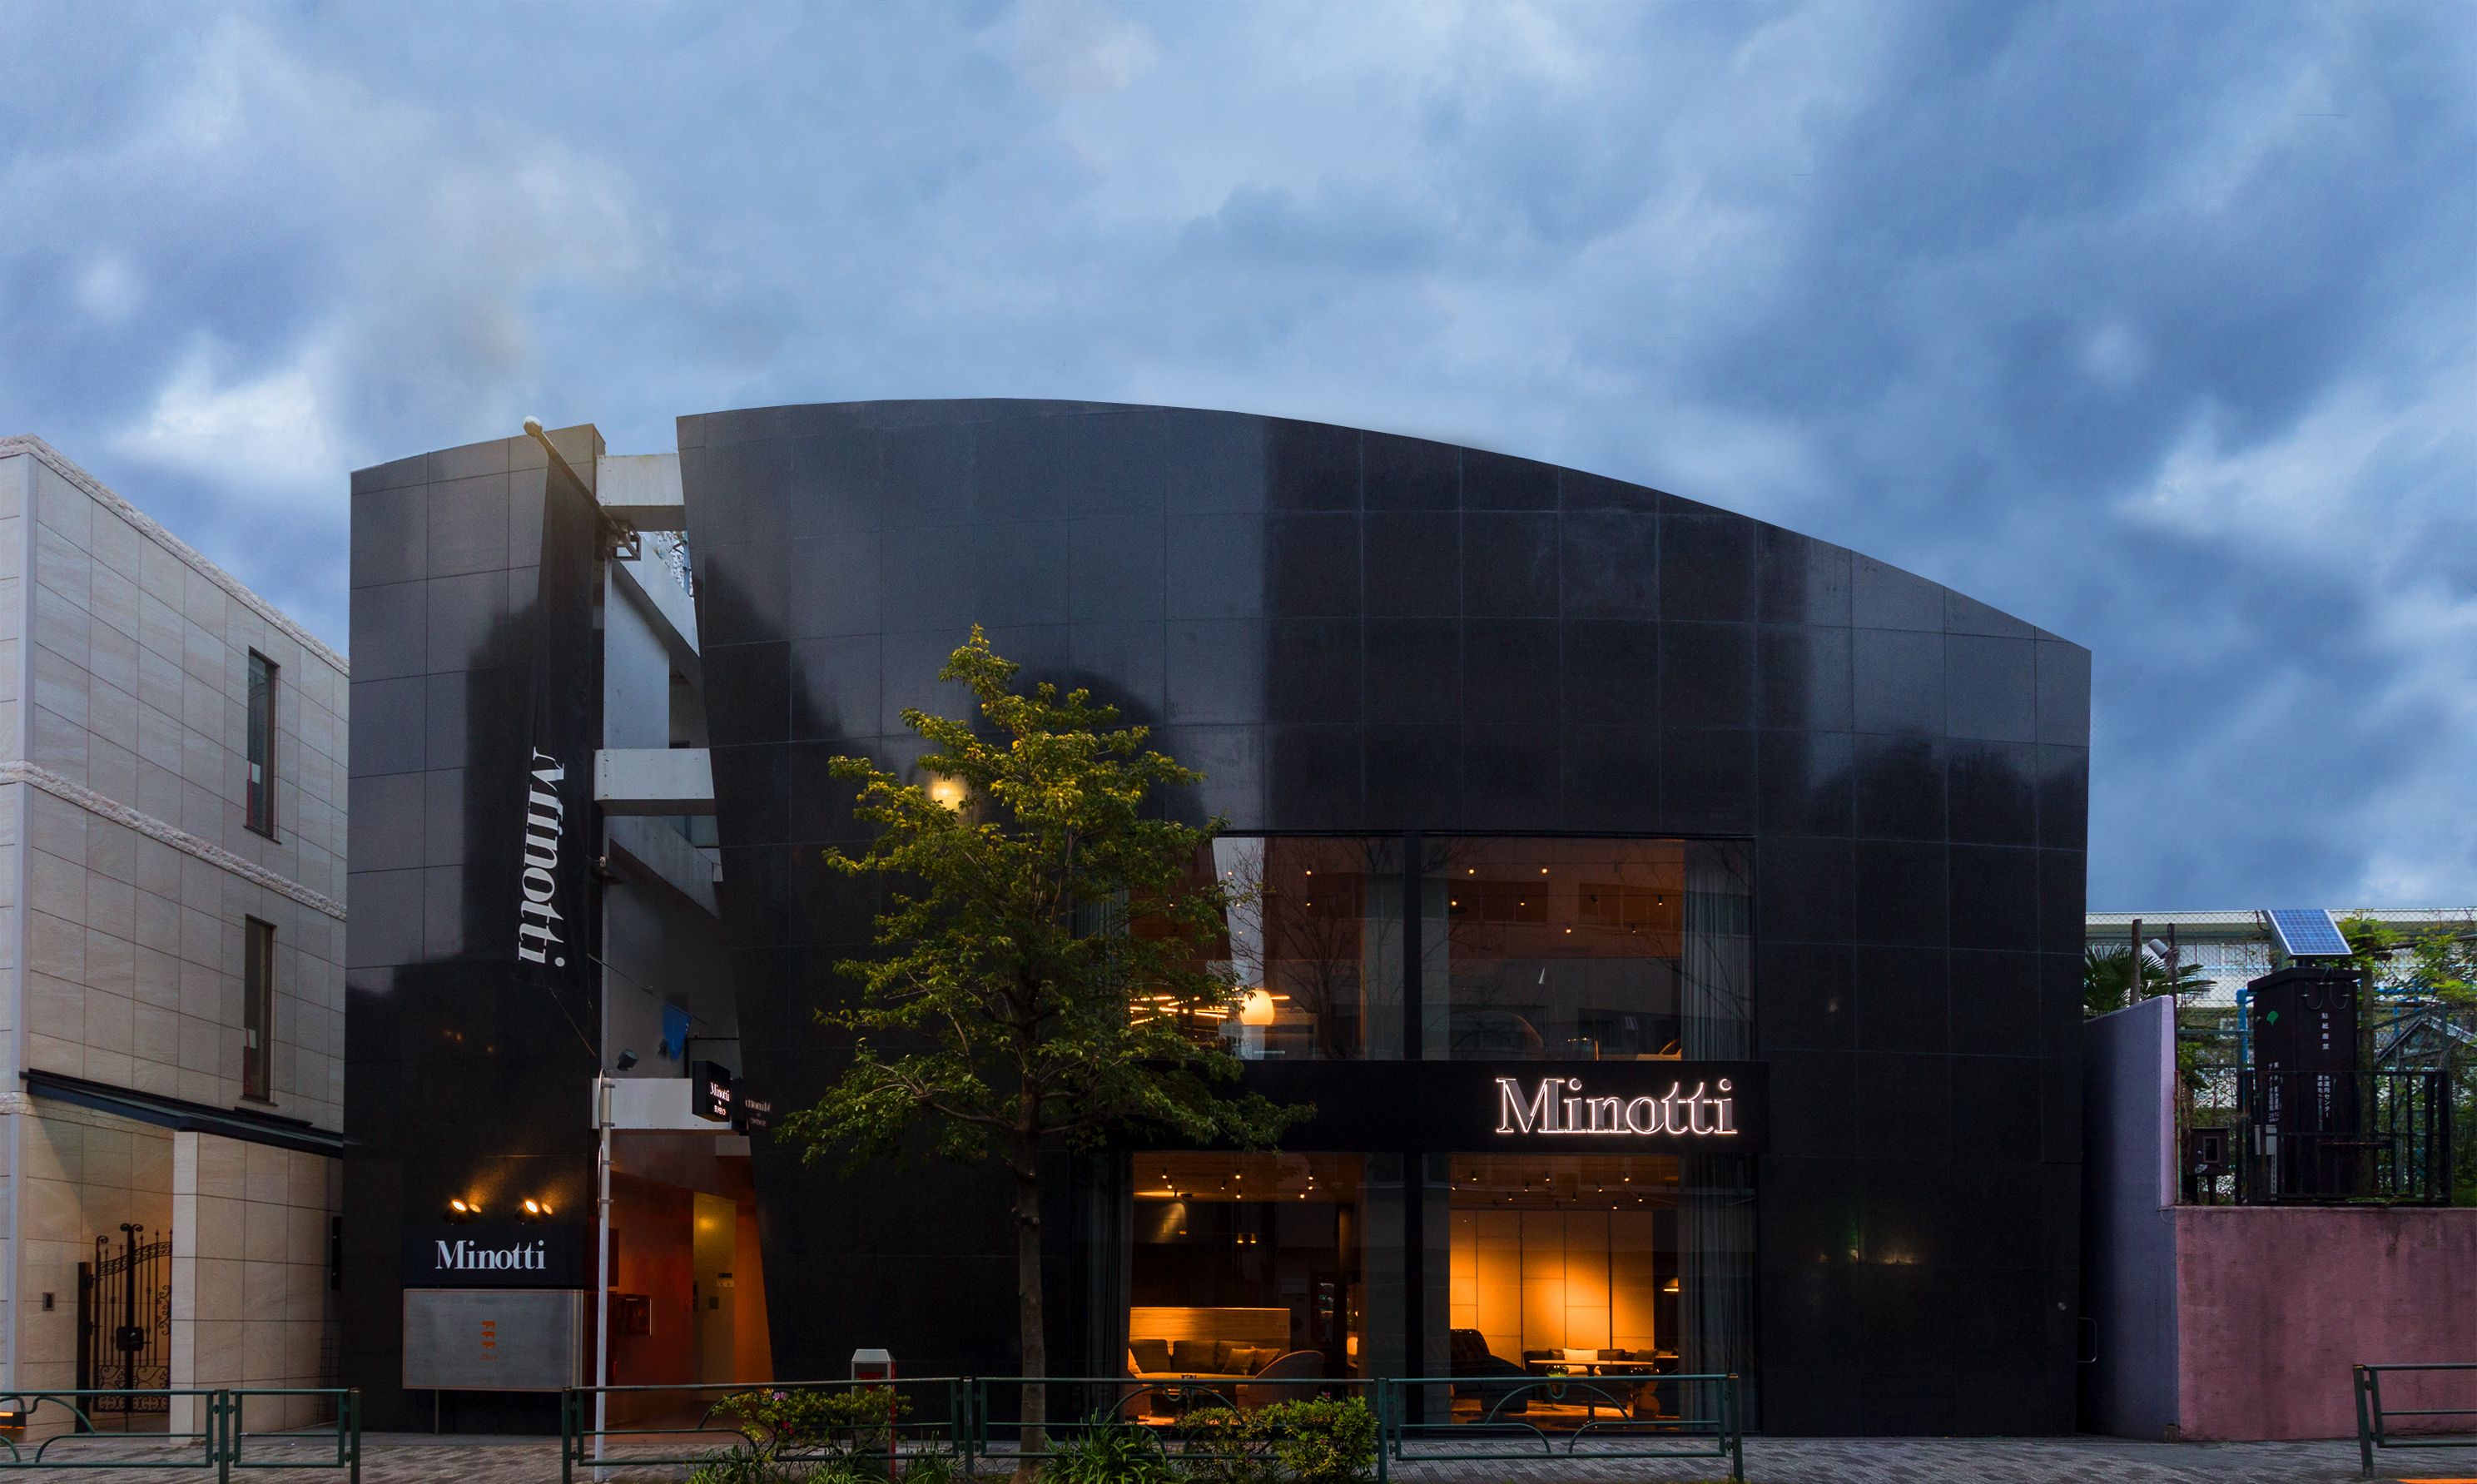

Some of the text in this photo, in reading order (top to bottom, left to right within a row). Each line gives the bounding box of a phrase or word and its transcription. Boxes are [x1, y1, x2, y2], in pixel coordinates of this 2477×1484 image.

[519, 746, 566, 967] Minotti
[710, 1082, 730, 1103] Minotti
[1495, 1077, 1739, 1135] Minotti
[434, 1240, 546, 1270] Minotti
